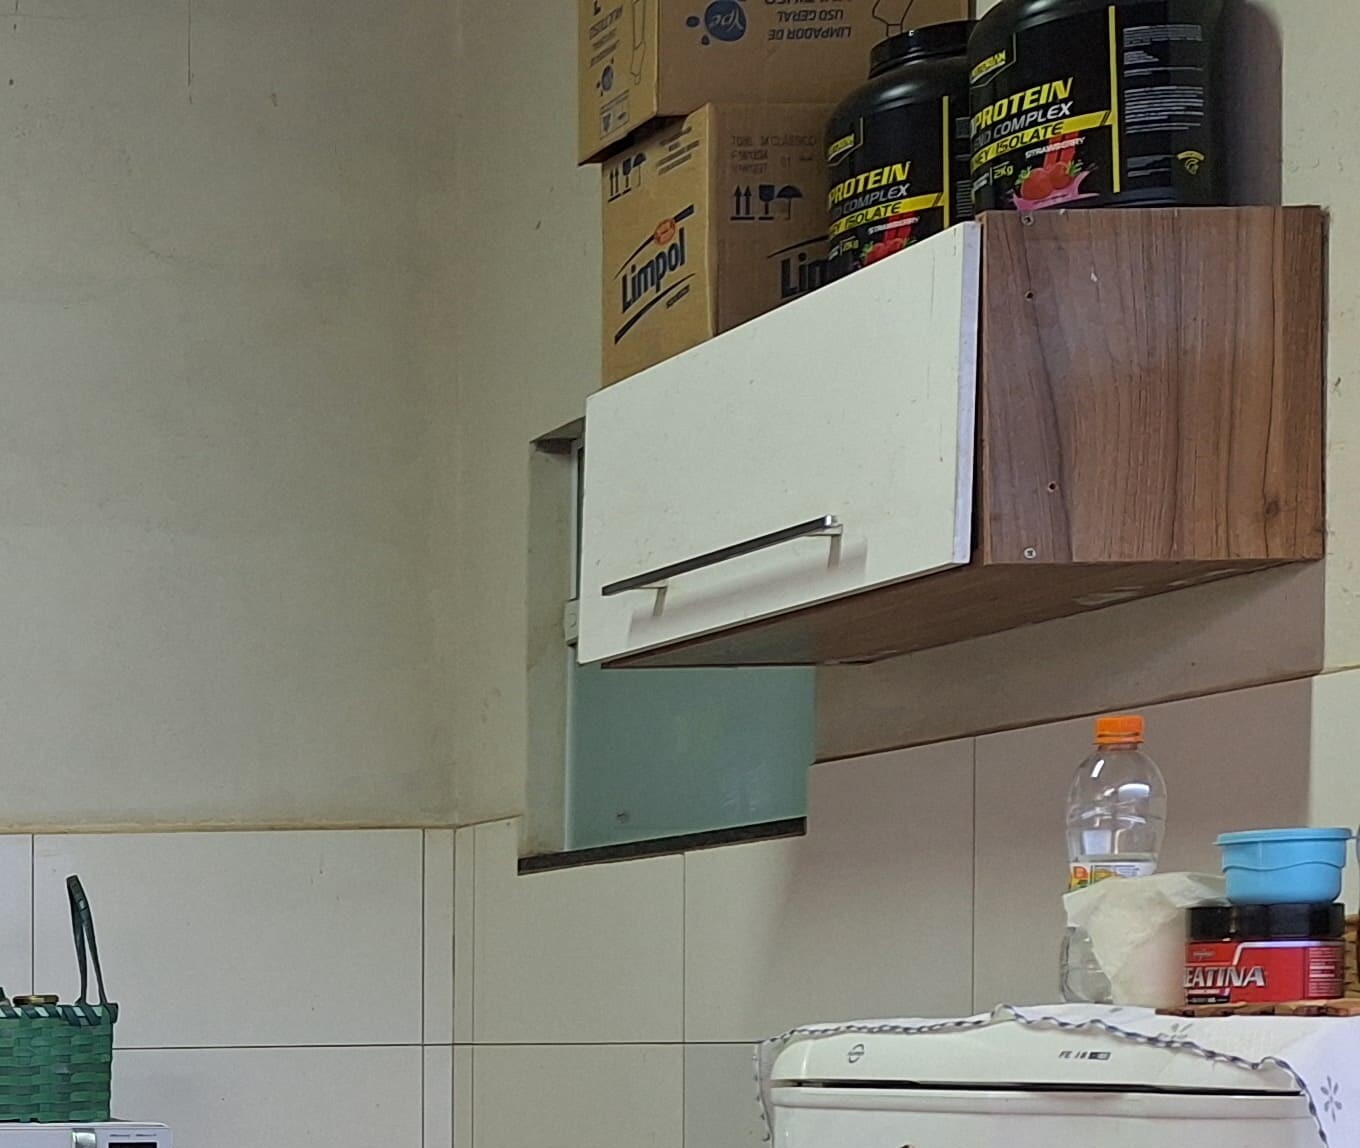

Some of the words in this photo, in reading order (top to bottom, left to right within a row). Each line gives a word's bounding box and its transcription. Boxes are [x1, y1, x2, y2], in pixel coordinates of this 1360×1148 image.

[776, 9, 817, 23] GERAL
[768, 28, 784, 41] DE
[787, 26, 852, 40] LIMPADOR
[993, 101, 1074, 139] COMPLEX
[829, 161, 912, 206] PROTEIN
[843, 183, 911, 215] COMPLEX
[622, 227, 686, 314] Limpol
